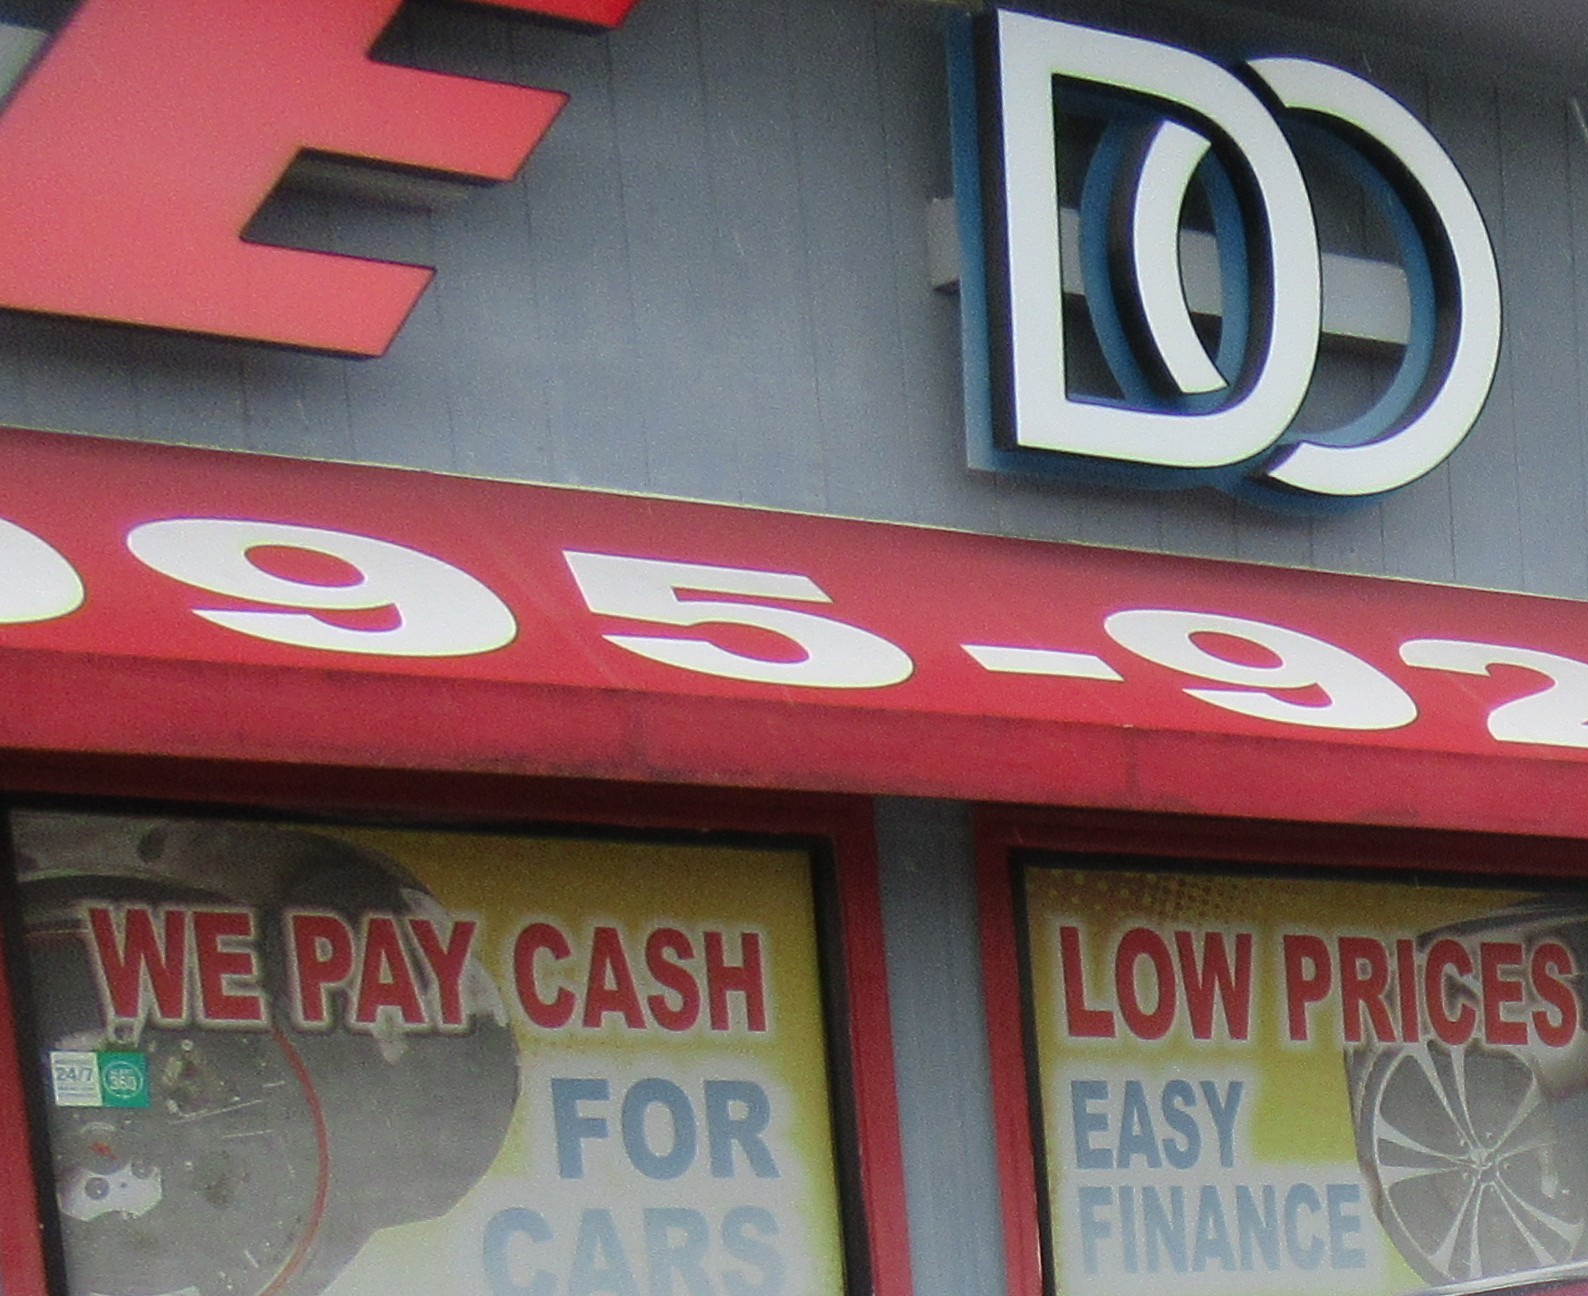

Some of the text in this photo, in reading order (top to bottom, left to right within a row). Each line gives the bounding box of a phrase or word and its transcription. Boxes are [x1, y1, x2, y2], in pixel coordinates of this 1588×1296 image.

[86, 905, 769, 1034] WE PAY CASH
[1059, 925, 1578, 1048] LOW PRICES
[550, 1077, 782, 1181] FOR
[1069, 1078, 1245, 1171] EASY
[1078, 1182, 1366, 1273] FINANCE
